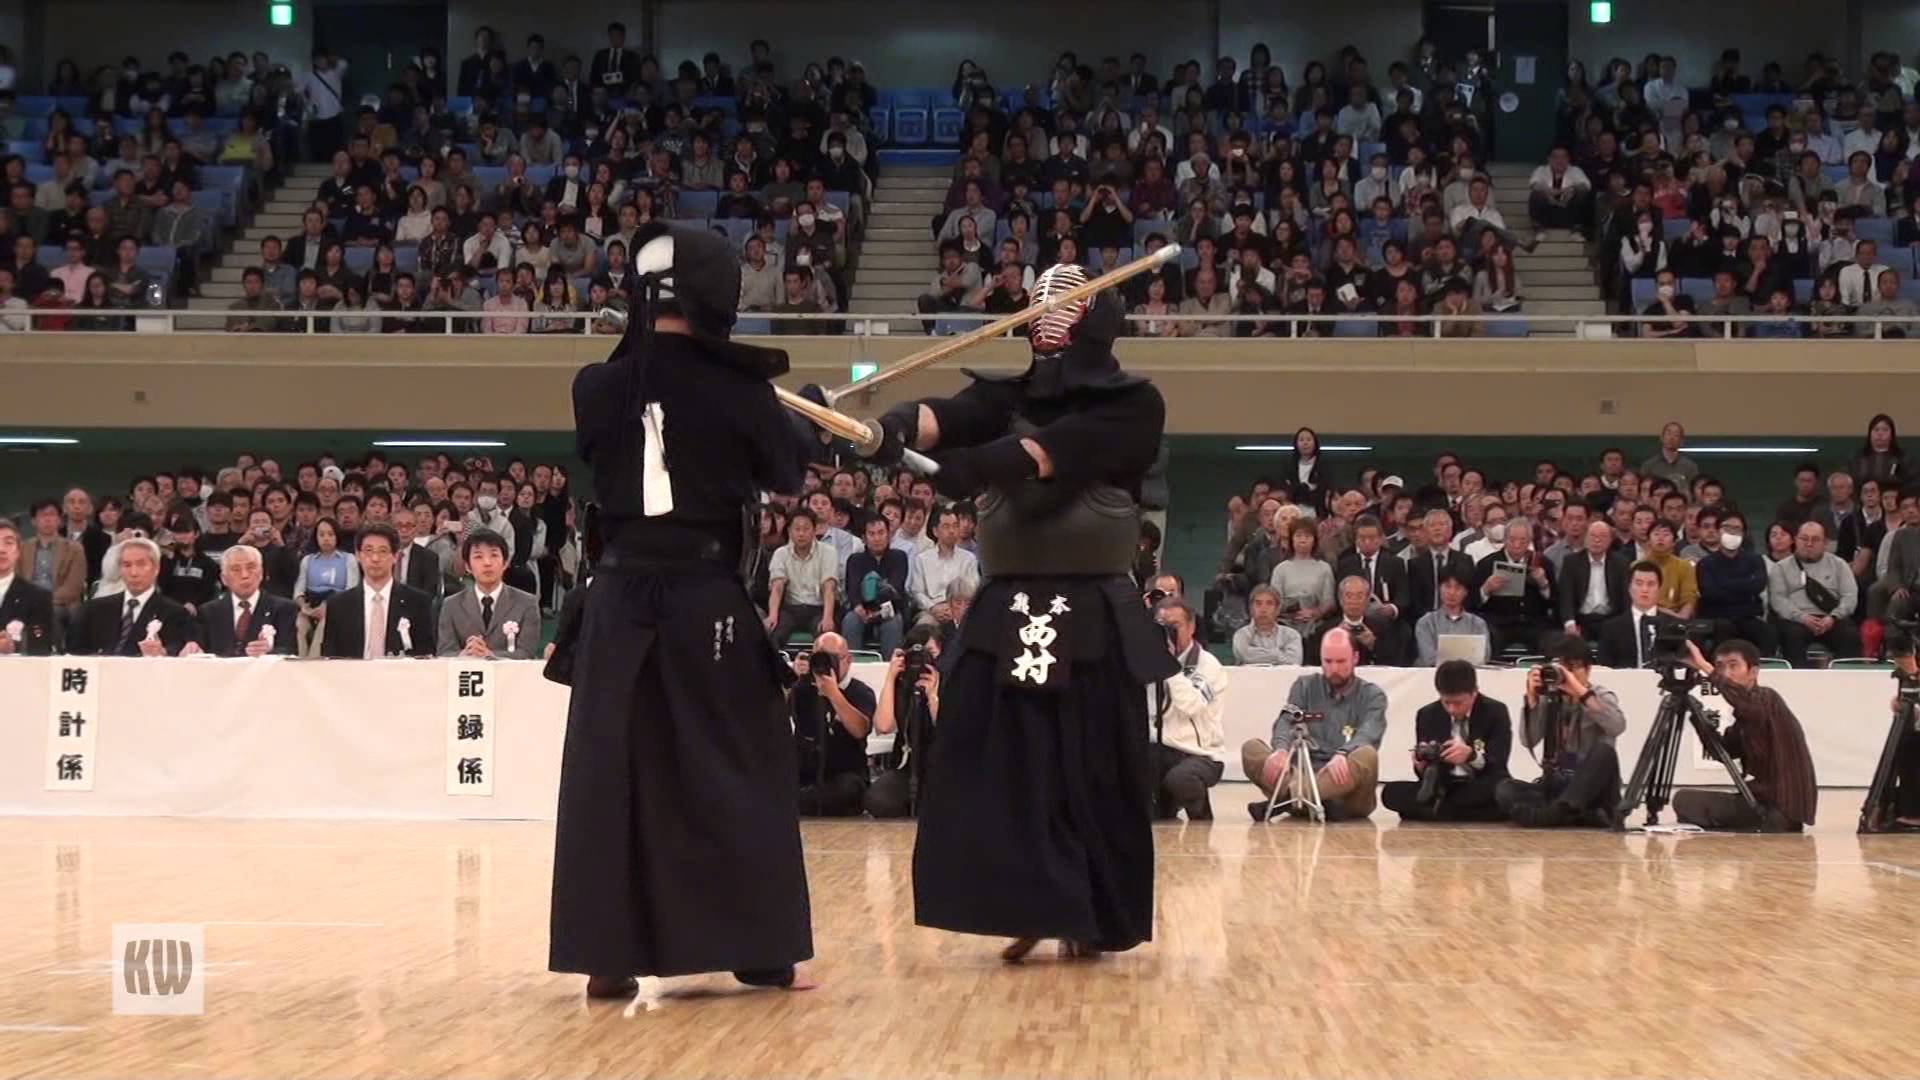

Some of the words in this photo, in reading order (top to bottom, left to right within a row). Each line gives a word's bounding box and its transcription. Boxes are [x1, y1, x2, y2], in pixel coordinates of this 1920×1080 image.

[1011, 614, 1058, 685] 西村
[56, 668, 88, 781] 時計係
[457, 671, 484, 785] 記録係
